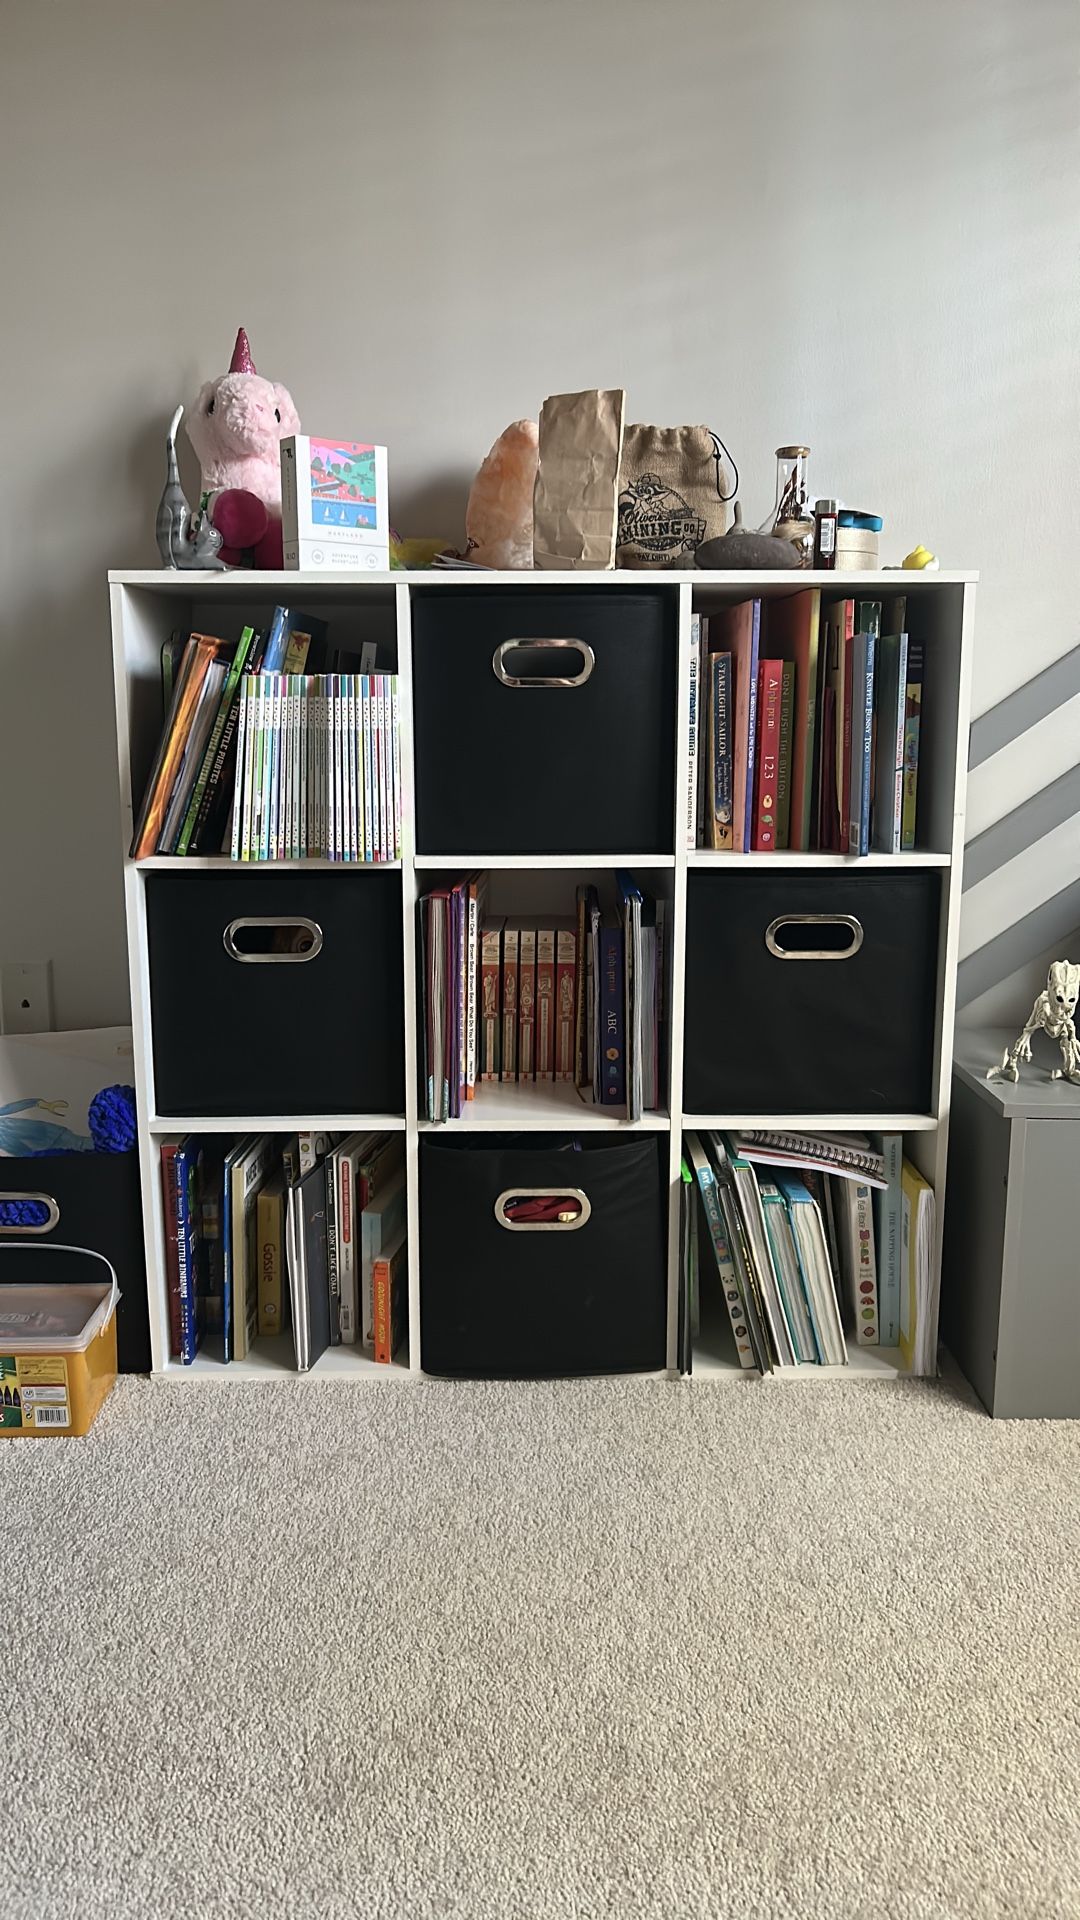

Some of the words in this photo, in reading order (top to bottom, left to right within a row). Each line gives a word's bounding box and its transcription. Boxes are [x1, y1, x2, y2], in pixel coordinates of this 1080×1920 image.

[621, 521, 682, 540] MINING
[718, 662, 727, 719] STARLIGHT
[229, 705, 240, 721] TEN
[780, 707, 790, 735] PUSH
[864, 707, 873, 735] BUNNY
[220, 720, 235, 750] LITTLE
[719, 720, 727, 757] SAILOR
[864, 735, 873, 753] TOO
[208, 750, 226, 785] PIRATES
[763, 755, 776, 779] 123
[607, 1009, 617, 1035] ABC
[701, 1171, 711, 1187] MY
[177, 1227, 185, 1240] TEN
[859, 1230, 871, 1264] Bear
[178, 1241, 186, 1263] LITTLE
[263, 1242, 277, 1283] Gossie
